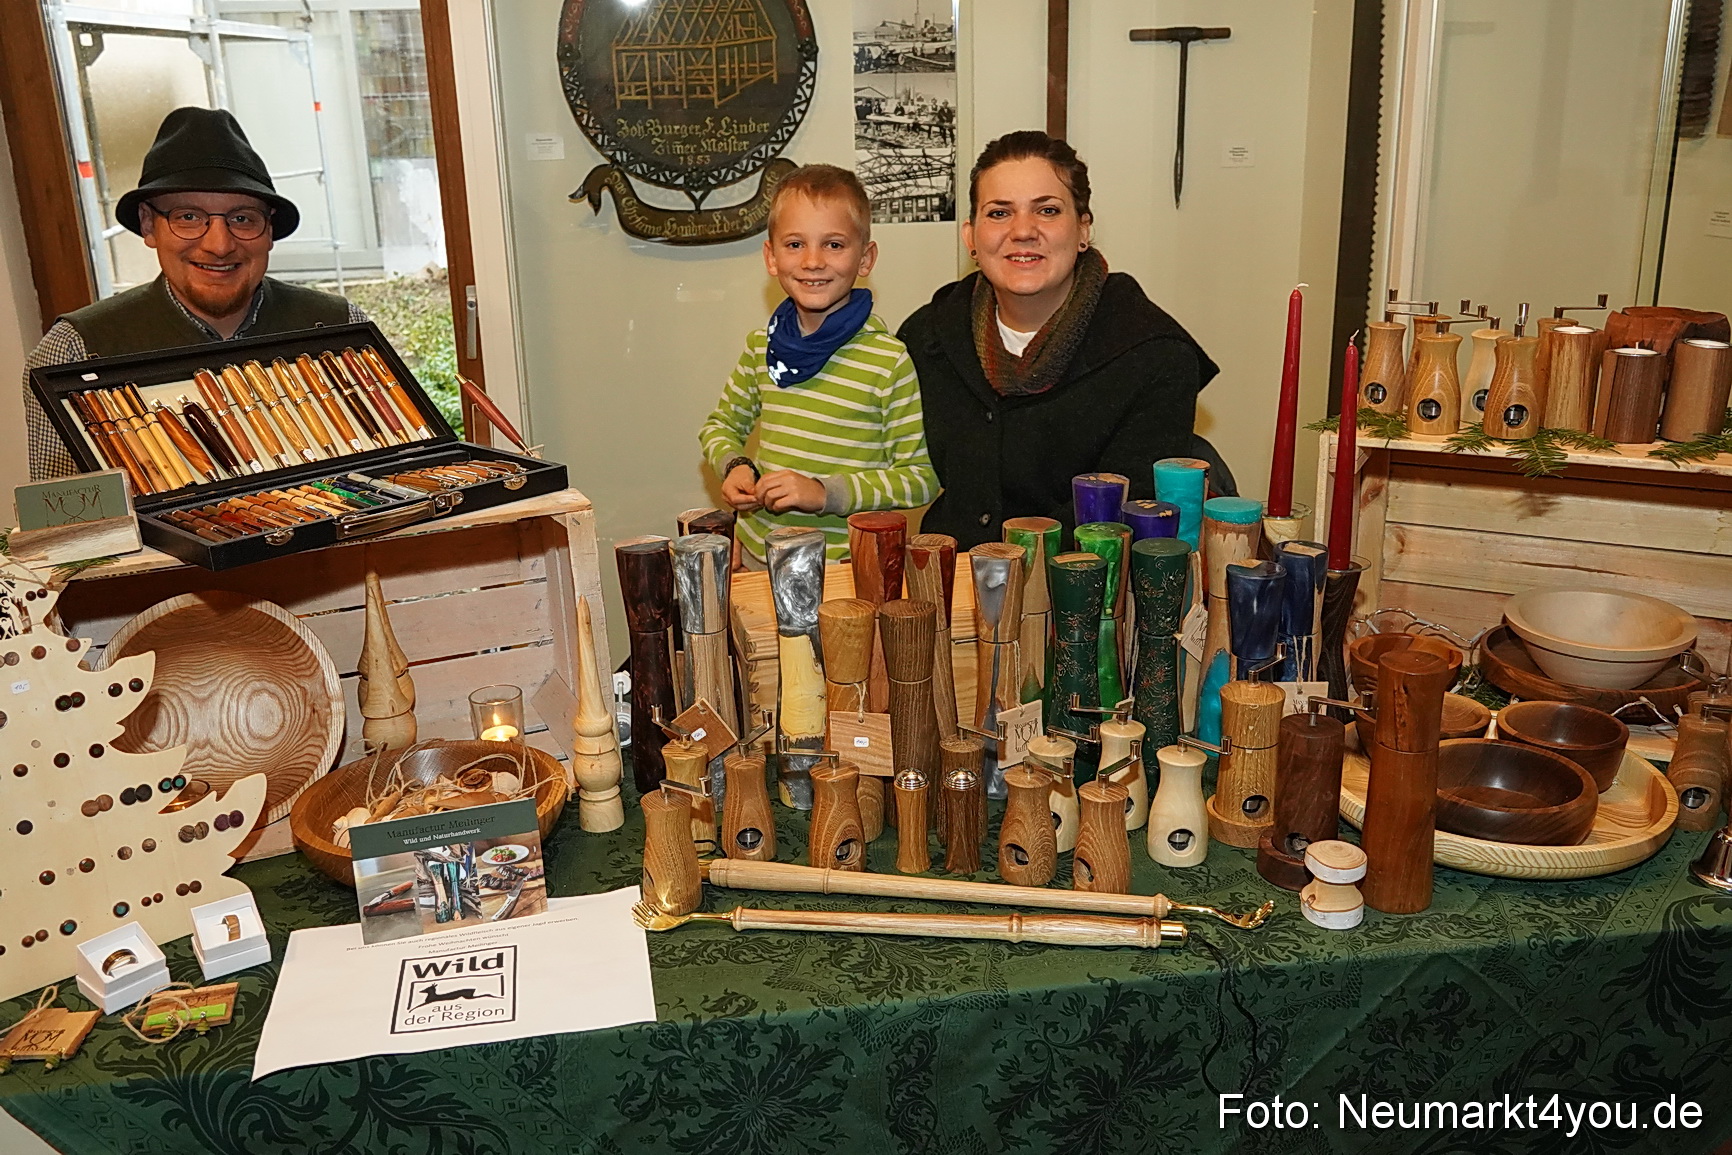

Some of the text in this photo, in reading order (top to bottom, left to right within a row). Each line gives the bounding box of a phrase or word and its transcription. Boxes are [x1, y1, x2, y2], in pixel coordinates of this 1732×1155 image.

[716, 116, 770, 137] Linder
[679, 154, 711, 165] 1853
[387, 815, 496, 840] Manufactur Meilinger
[403, 828, 482, 845] Wild und Naturhandwerk
[412, 952, 504, 979] Wild
[404, 1007, 505, 1026] der Region
[432, 1003, 463, 1013] aus
